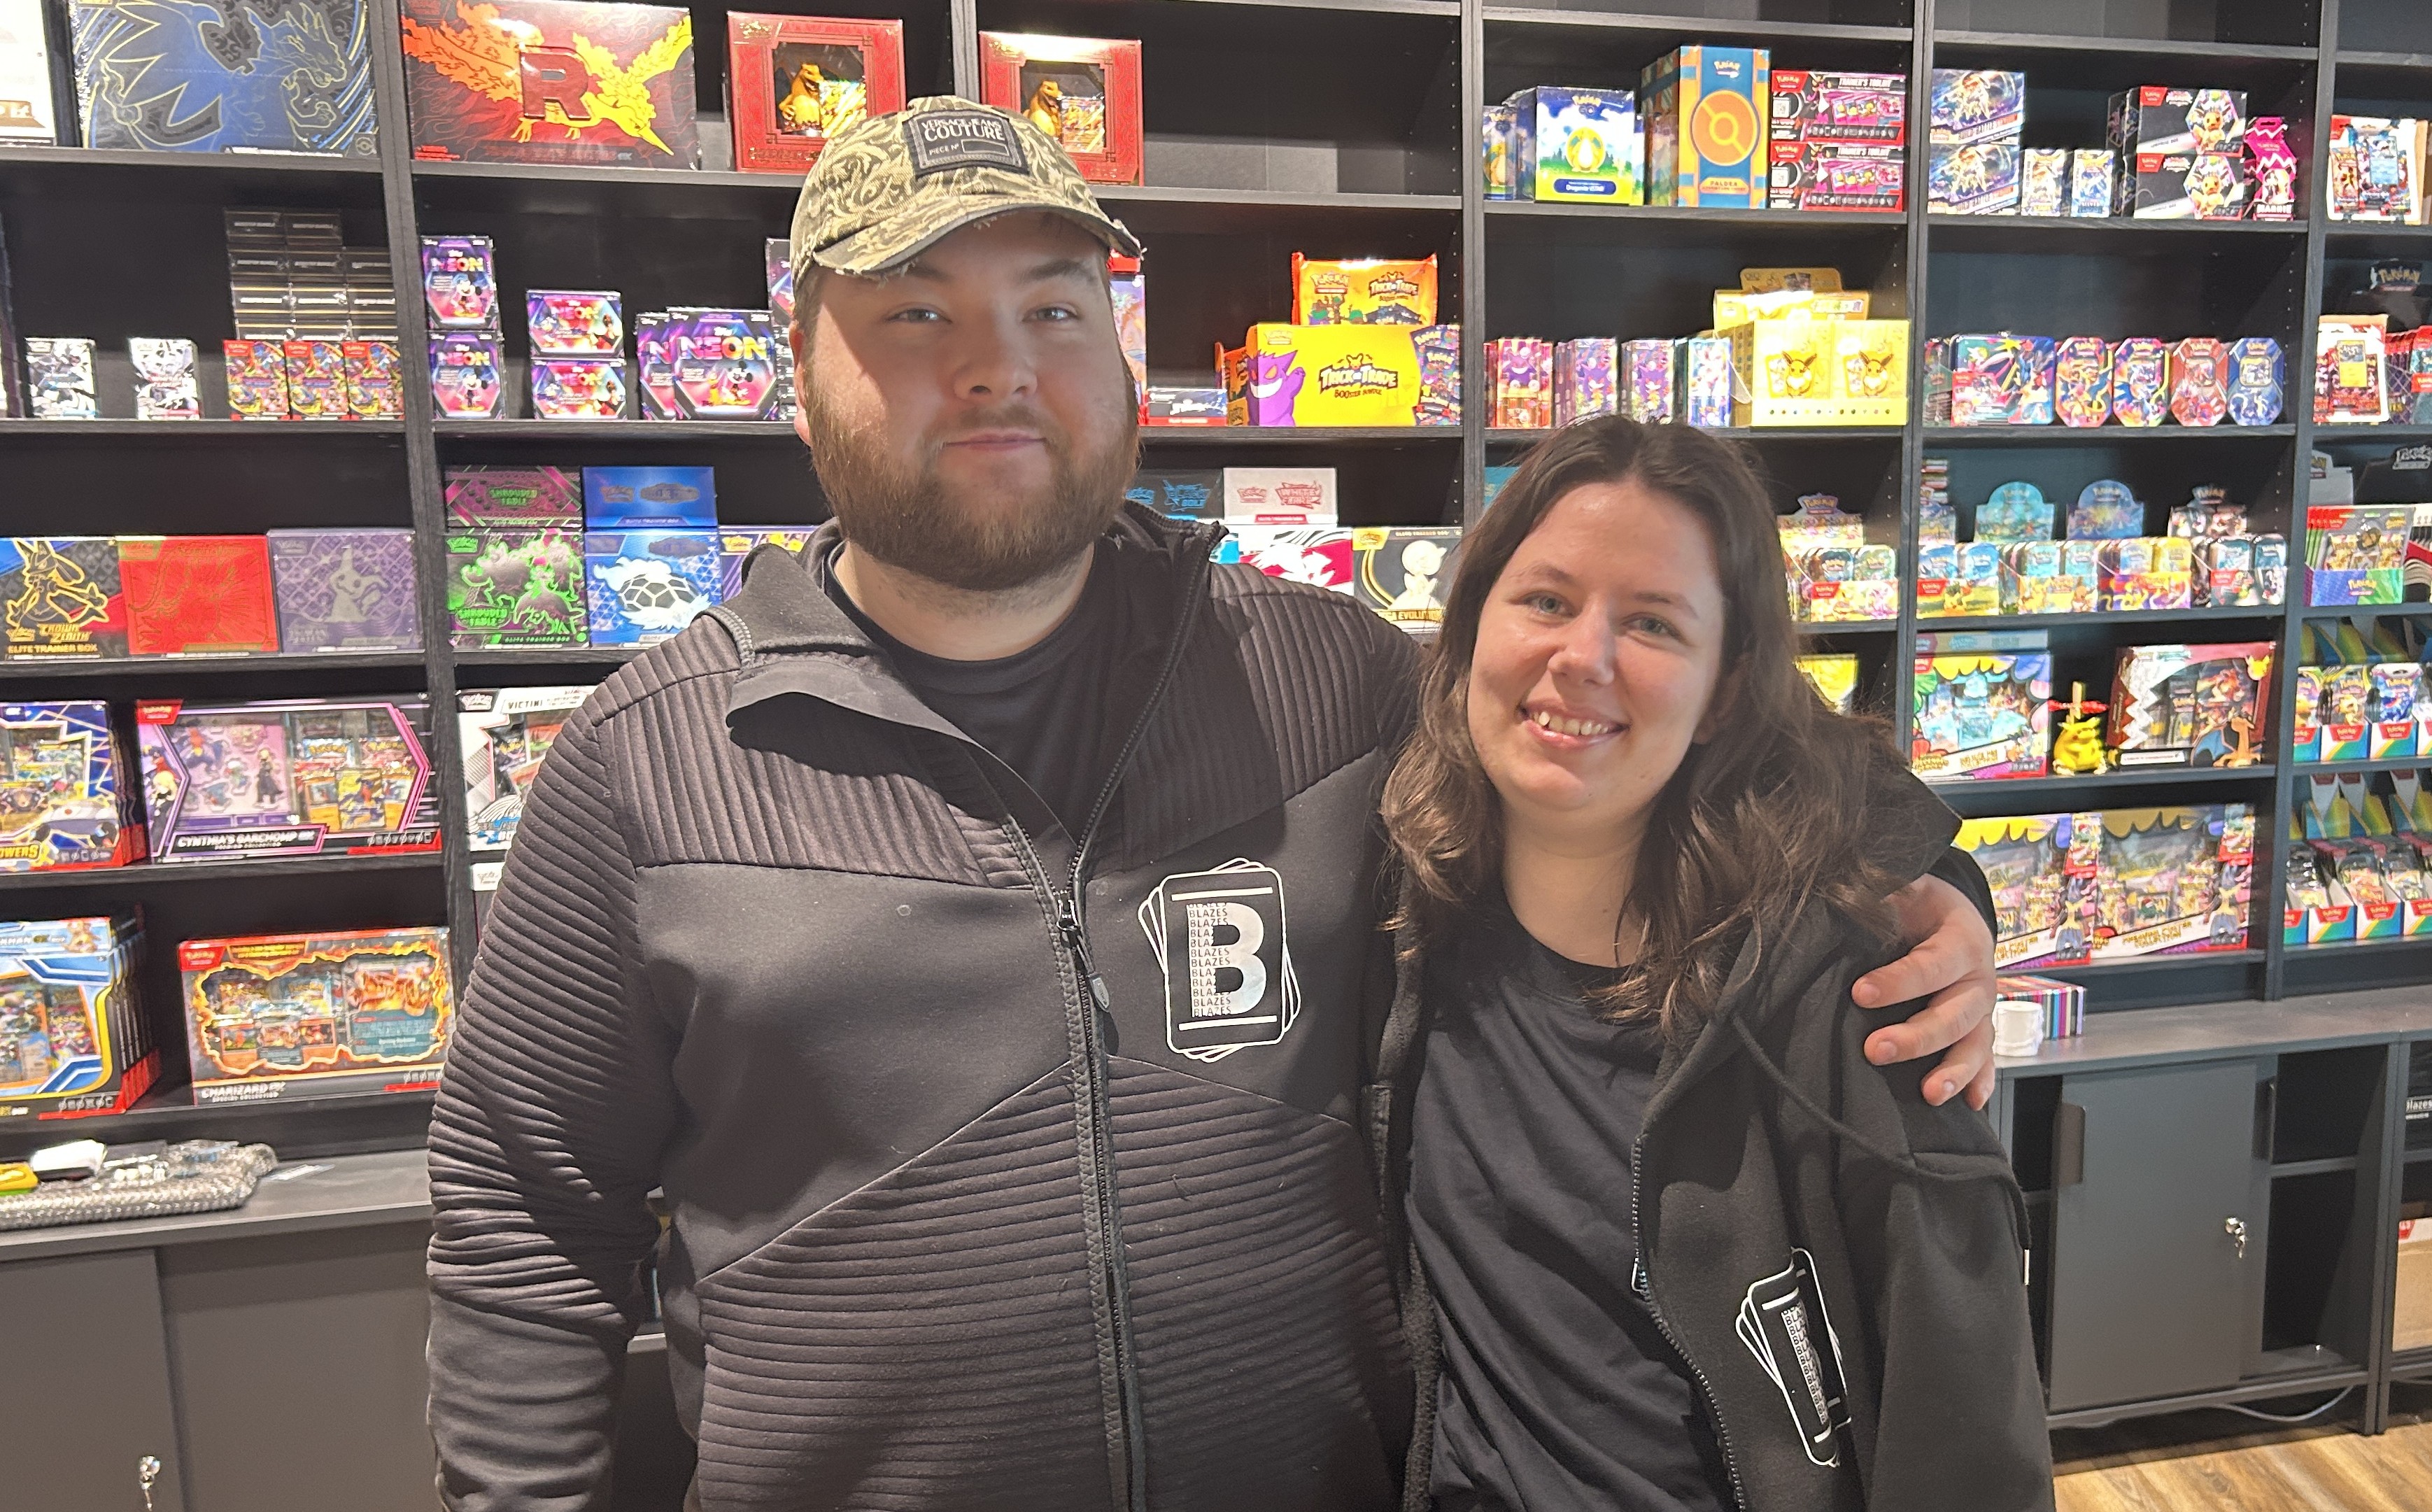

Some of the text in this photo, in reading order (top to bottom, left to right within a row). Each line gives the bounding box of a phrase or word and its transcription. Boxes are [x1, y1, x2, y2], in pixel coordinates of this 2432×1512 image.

[519, 46, 592, 121] R
[921, 118, 1002, 130] VERSACE JEANS
[924, 125, 1005, 141] COUTURE
[928, 145, 949, 156] PIECE
[430, 257, 484, 271] NEON
[677, 336, 770, 360] NEON
[437, 351, 490, 366] NEON
[1320, 365, 1398, 388] TRICK TRADE
[8, 643, 98, 653] ELITE TRAINER BOX
[508, 700, 544, 709] VICTINI
[178, 833, 236, 847] CYNTHIA'S
[236, 831, 298, 845] GARCHOMP
[1189, 907, 1229, 918] BLAZES
[1190, 918, 1229, 928] BLAZES
[1191, 947, 1230, 958] BLAZES
[1192, 956, 1231, 967] BLAZES
[1194, 996, 1231, 1007] BLAZES
[1194, 1005, 1231, 1016] BLAZES
[202, 1083, 269, 1098] CHARIZARD
